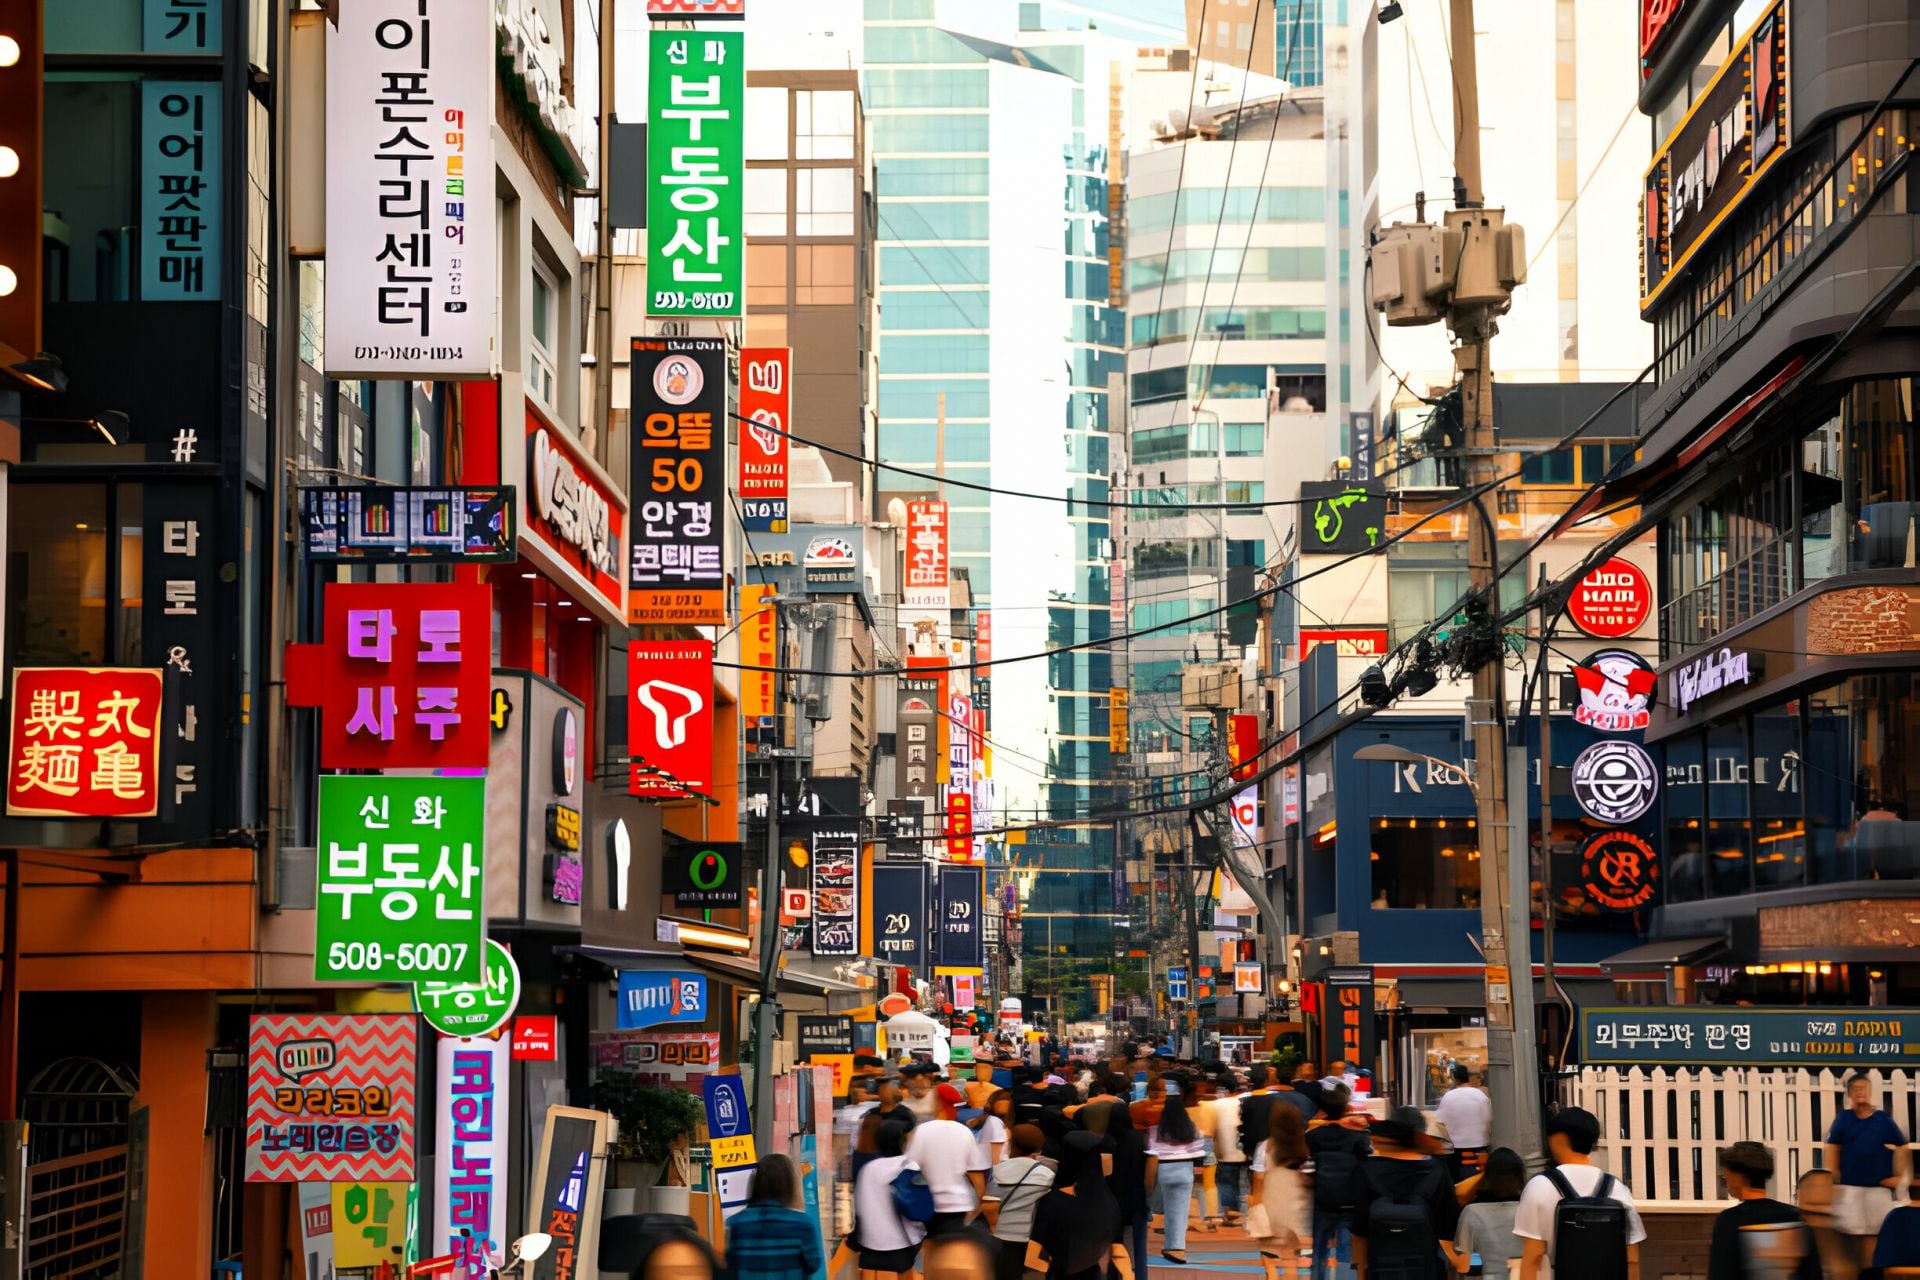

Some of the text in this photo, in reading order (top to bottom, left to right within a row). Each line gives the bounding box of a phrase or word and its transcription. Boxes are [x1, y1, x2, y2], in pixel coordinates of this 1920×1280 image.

[157, 93, 208, 293] 이어팟판매
[374, 0, 435, 337] 이폰수리센터
[660, 74, 730, 282] 부동산
[650, 457, 704, 493] 50
[641, 501, 713, 538] 안경
[347, 608, 463, 663] 타로
[345, 685, 462, 741] 사주
[321, 841, 481, 921] 부동산
[327, 941, 469, 972] 508-5007
